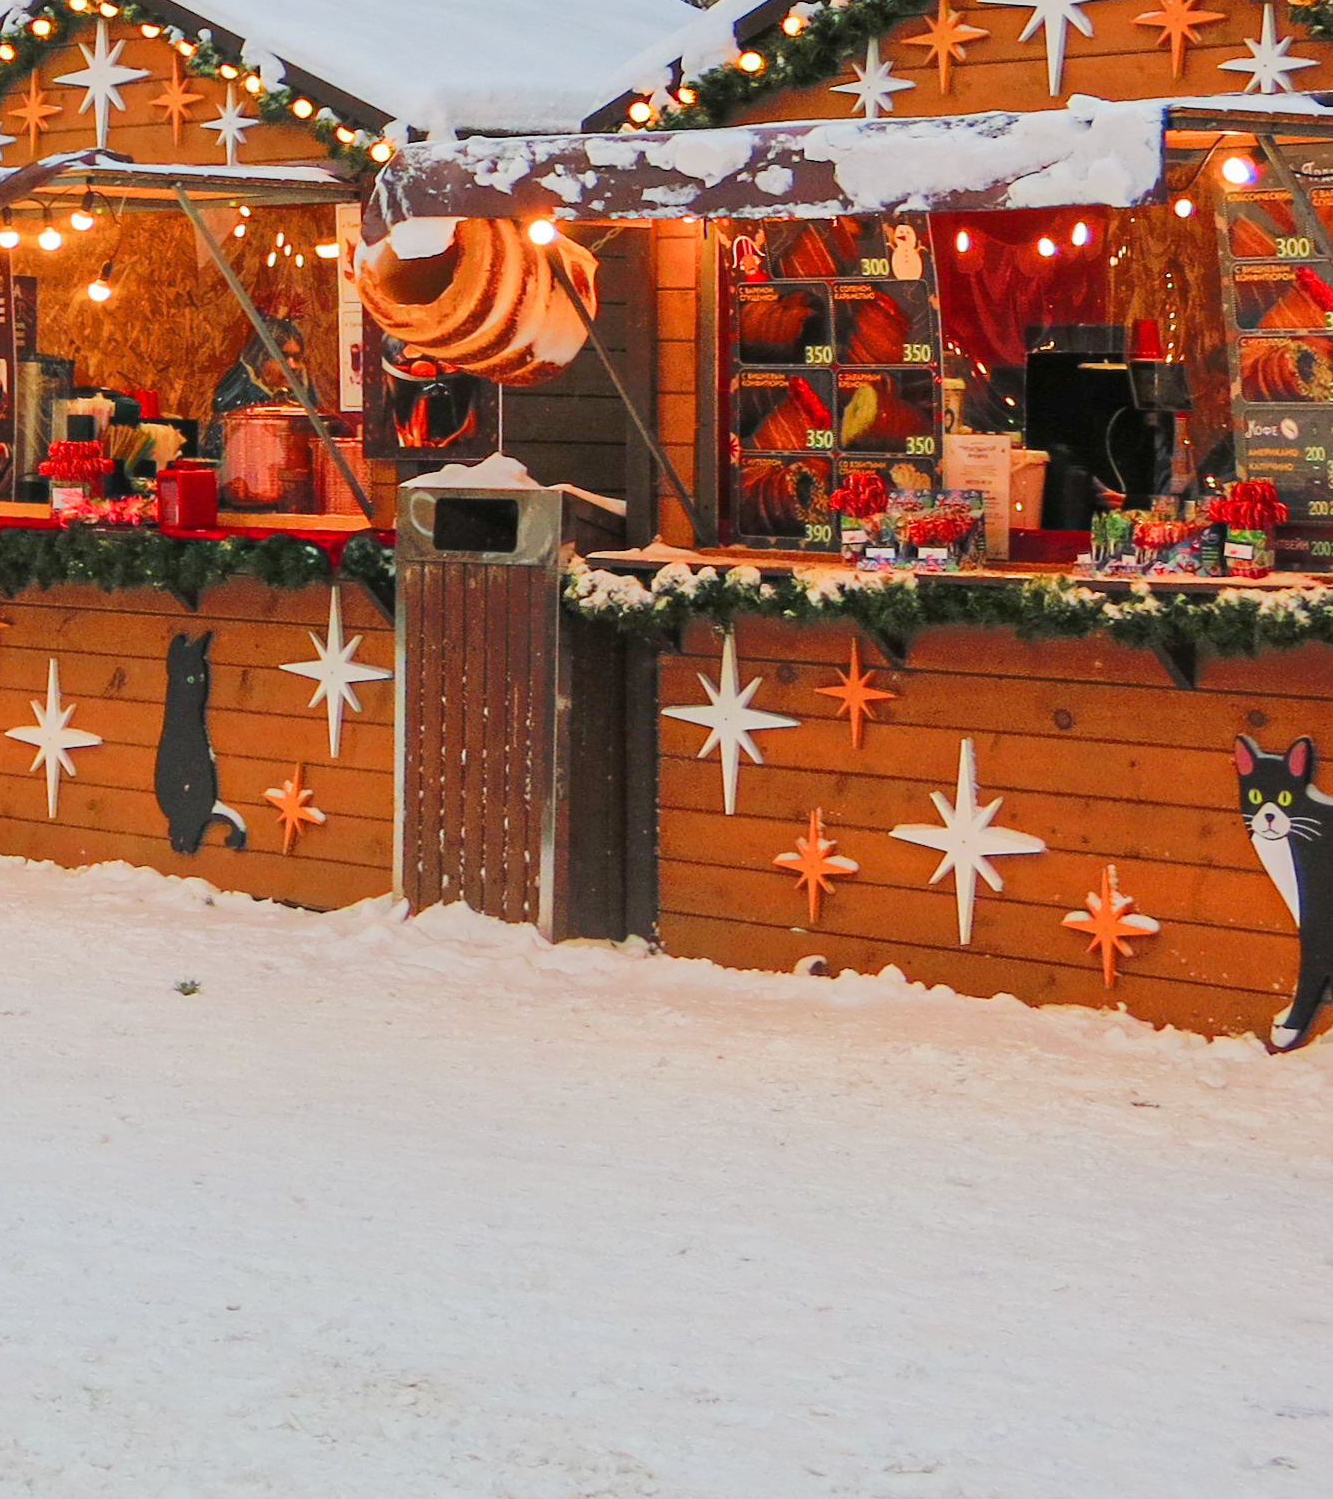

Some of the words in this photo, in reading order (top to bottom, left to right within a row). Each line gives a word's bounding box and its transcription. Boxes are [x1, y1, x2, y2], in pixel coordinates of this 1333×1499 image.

[1275, 238, 1310, 257] 300
[861, 258, 890, 276] 300
[805, 346, 833, 364] 350
[903, 344, 931, 362] 350
[807, 430, 834, 448] 350
[906, 437, 935, 455] 350
[1305, 446, 1326, 461] 200
[1308, 501, 1328, 516] 200
[805, 525, 831, 542] 390
[1310, 541, 1330, 556] 200
